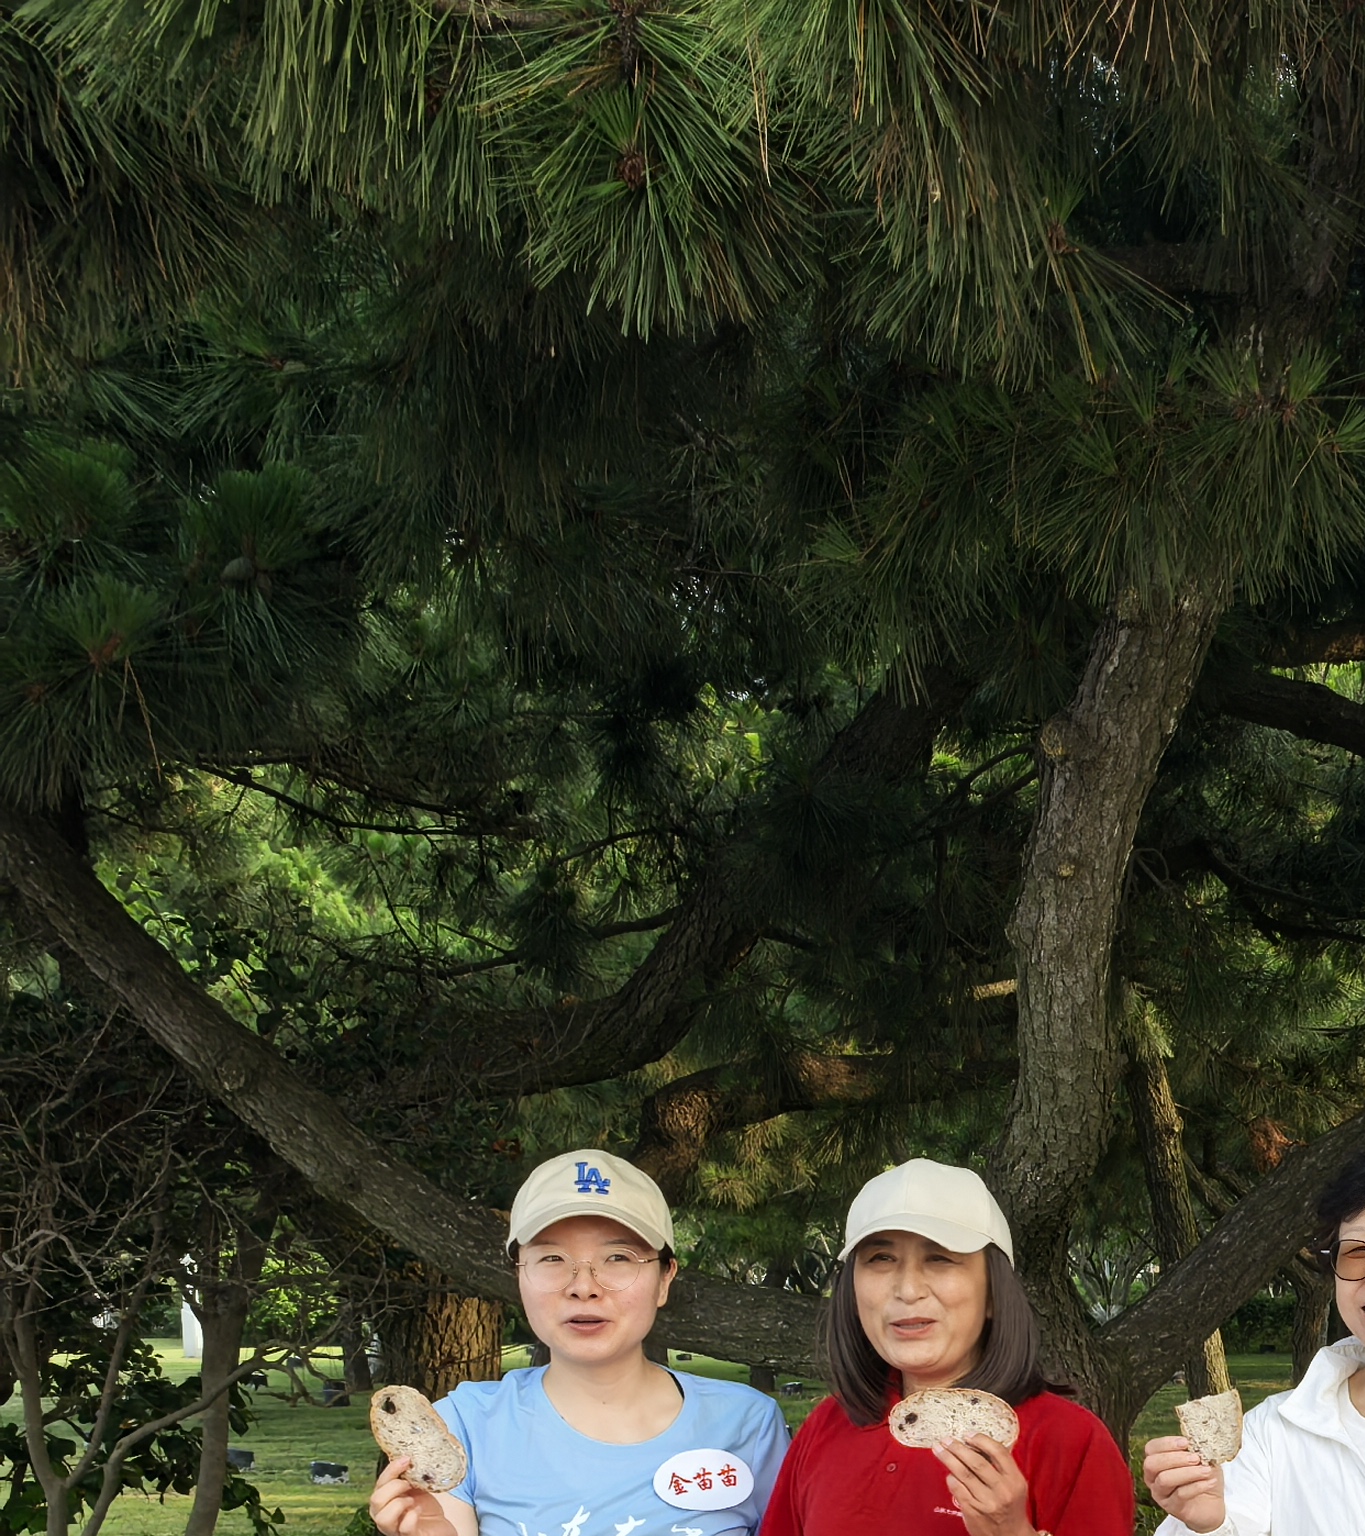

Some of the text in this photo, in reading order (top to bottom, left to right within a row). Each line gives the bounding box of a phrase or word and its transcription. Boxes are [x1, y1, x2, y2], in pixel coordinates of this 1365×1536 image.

[574, 1162, 611, 1195] LA
[668, 1464, 738, 1495] 金苗苗
